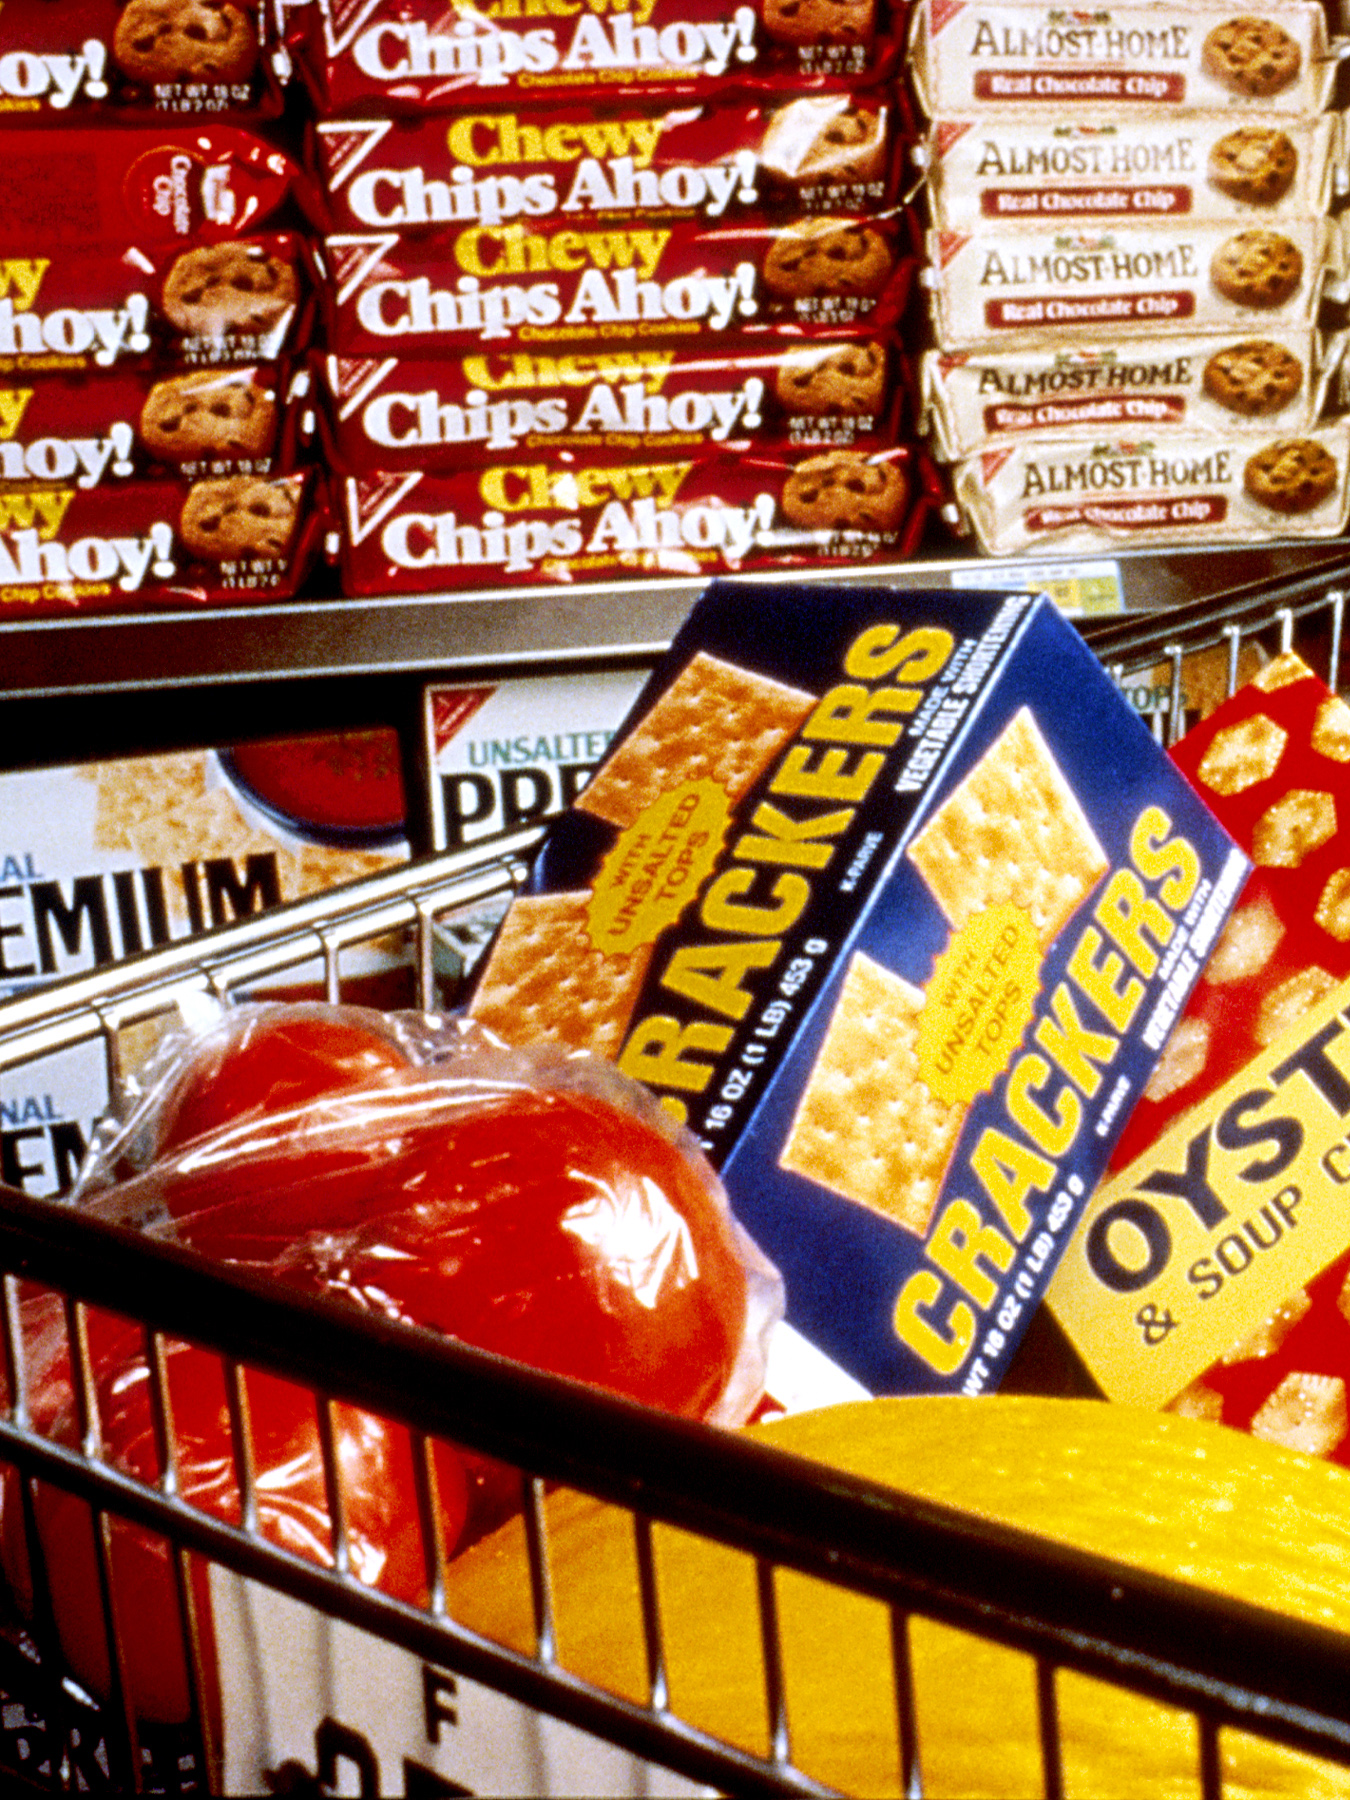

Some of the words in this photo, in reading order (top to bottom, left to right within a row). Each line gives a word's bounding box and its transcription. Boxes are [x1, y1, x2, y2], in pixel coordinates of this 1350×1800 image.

[353, 19, 558, 87] Chips
[562, 6, 757, 77] Ahoy!
[971, 20, 1096, 58] ALMOST
[1105, 25, 1190, 60] HOME
[991, 74, 1033, 95] Real
[1035, 73, 1122, 95] Chocolate
[1126, 73, 1168, 98] Chip
[447, 114, 664, 169] Chewy
[976, 140, 1099, 176] ALMOST
[1110, 138, 1196, 173] HOME
[348, 165, 558, 226] Chips
[561, 148, 758, 216] Ahoy!
[997, 190, 1038, 211] Real
[1040, 189, 1128, 211] Chocolate
[1133, 188, 1175, 213] Chip
[453, 222, 672, 279] Chewy
[979, 249, 1103, 286] ALMOST
[1114, 244, 1200, 280] HOME
[356, 276, 562, 341] Chips
[564, 262, 757, 331] Ahoy!
[1003, 301, 1047, 322] Real
[1049, 298, 1133, 320] Chocolate
[1136, 296, 1179, 316] Chip
[462, 352, 674, 393] Chewy
[979, 365, 1099, 395] ALMOST
[1106, 357, 1193, 388] HOME
[362, 388, 568, 451] Chips
[572, 377, 763, 441] Ahoy!
[1036, 401, 1124, 425] Chocolate
[1126, 399, 1171, 420] Chip
[1020, 461, 1142, 500] ALMOST
[1148, 452, 1233, 488] HOME
[380, 510, 584, 574] Chips
[586, 492, 775, 560] Ahoy!
[1171, 499, 1212, 521] Chip
[894, 696, 969, 793] VEGETABLE
[908, 686, 951, 740] MADE
[608, 793, 703, 937] UNSALTED
[611, 833, 652, 888] WITH
[616, 623, 955, 1127] RACKERS
[656, 831, 712, 902] TOPS
[935, 924, 1020, 1076] UNSALTED
[974, 979, 1023, 1057] TOPS
[705, 1103, 734, 1130] 16
[721, 1069, 754, 1102] OZ
[754, 999, 792, 1039] LB)
[780, 958, 814, 997] 453
[893, 805, 1201, 1375] CRACKERS
[997, 1294, 1023, 1332] OZ
[1026, 1231, 1056, 1274] LB)
[1135, 1303, 1181, 1347] &
[1186, 1183, 1305, 1302] SOUP
